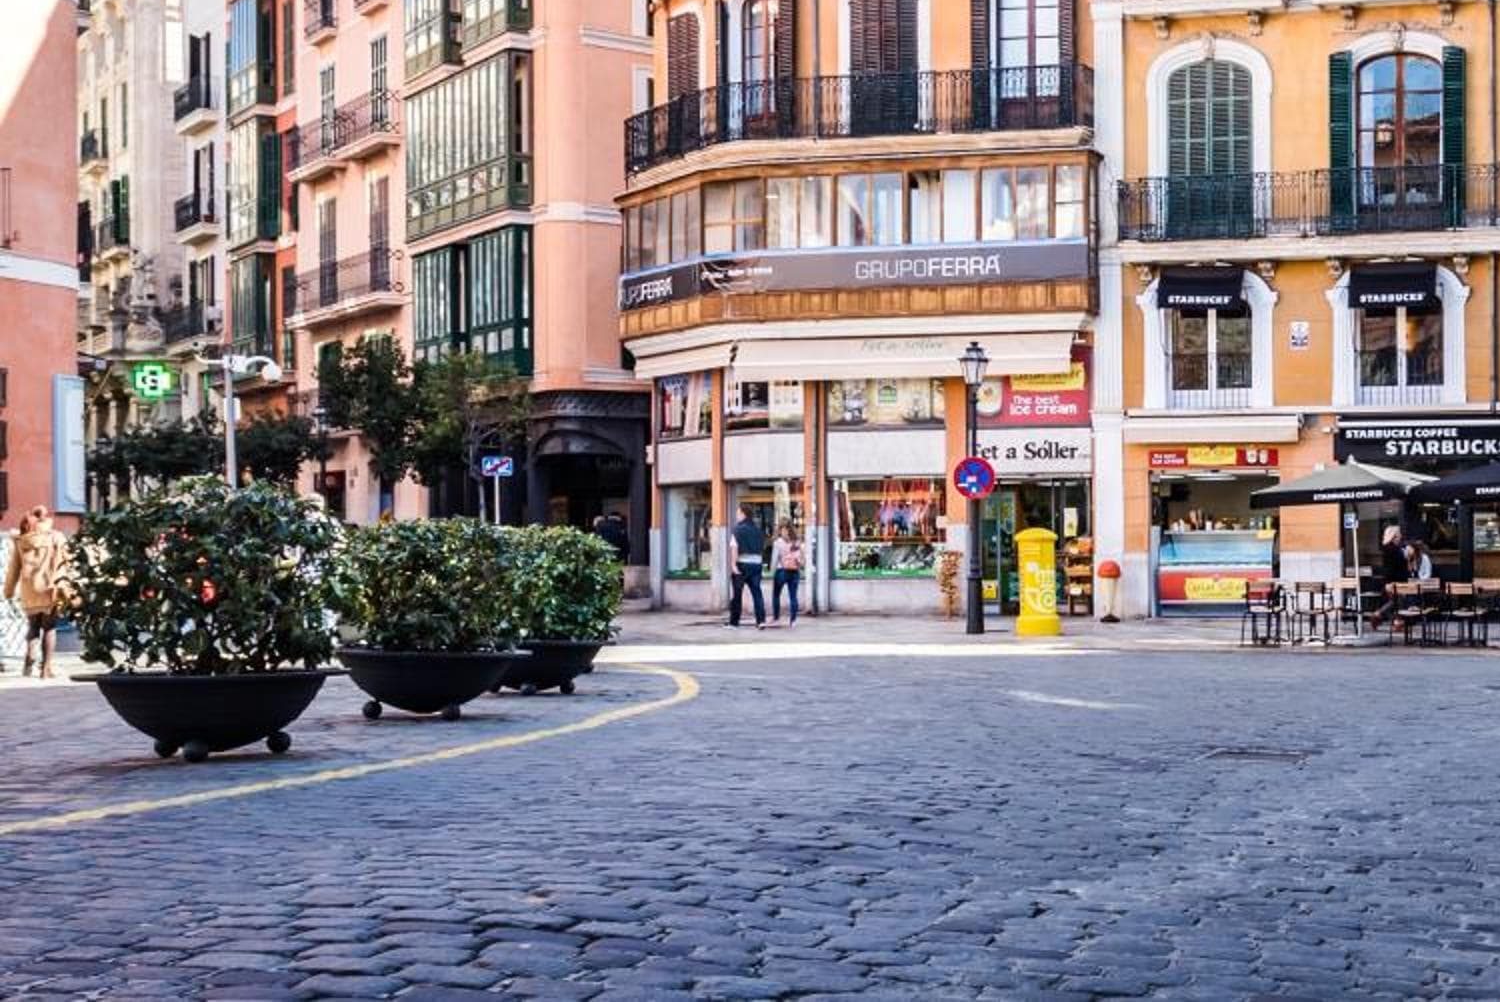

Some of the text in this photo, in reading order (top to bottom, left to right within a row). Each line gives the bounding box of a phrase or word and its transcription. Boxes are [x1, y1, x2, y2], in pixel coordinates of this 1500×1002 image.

[1167, 296, 1232, 304] STARBUCKS
[1359, 293, 1426, 304] STARBUCKS
[1034, 404, 1078, 415] cream
[1345, 428, 1458, 439] STARBUCKS COFFEE
[1005, 448, 1017, 459] a
[1024, 440, 1078, 459] Sóller
